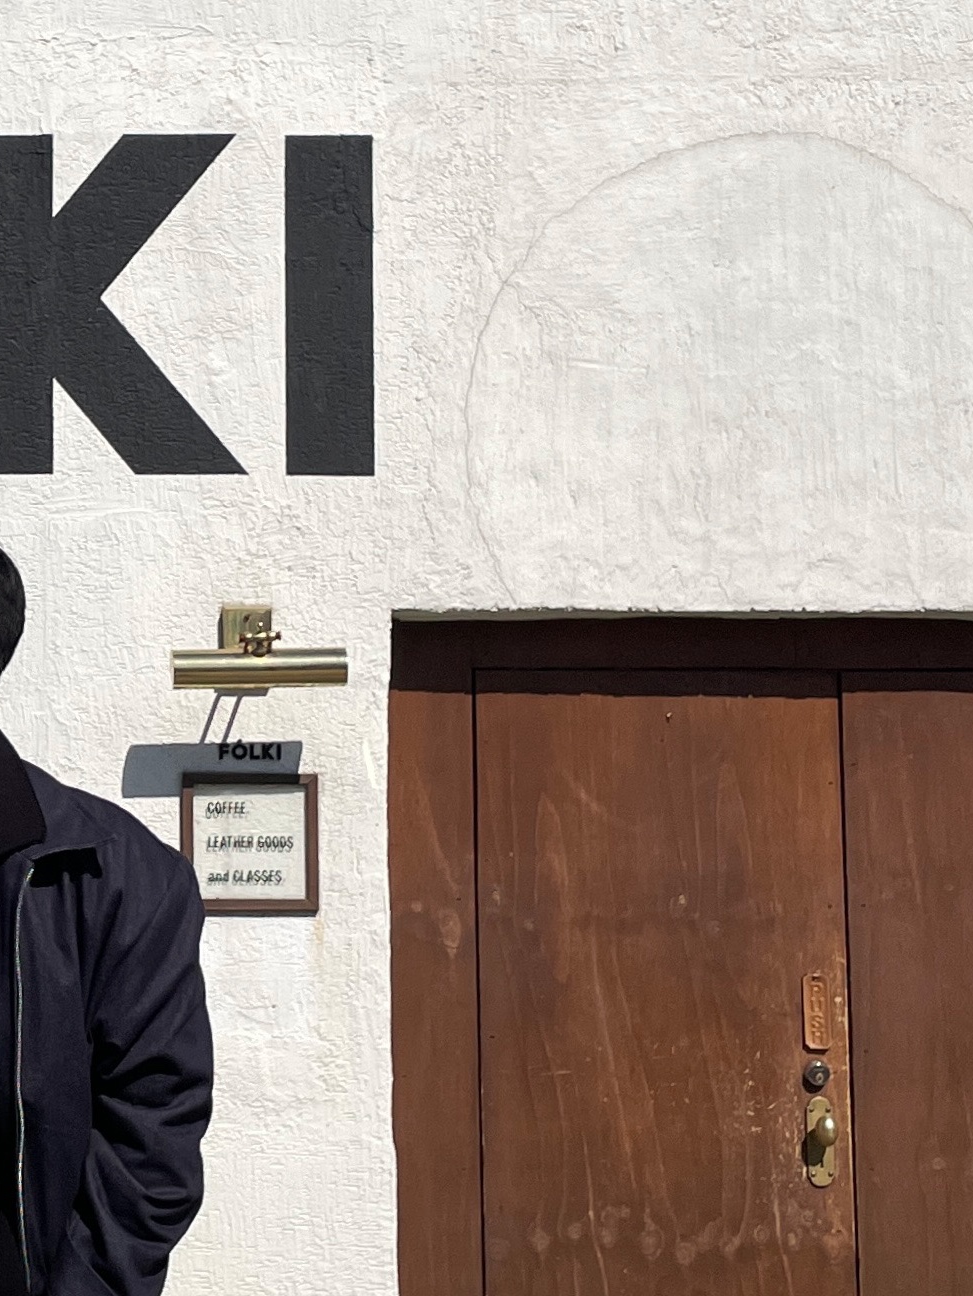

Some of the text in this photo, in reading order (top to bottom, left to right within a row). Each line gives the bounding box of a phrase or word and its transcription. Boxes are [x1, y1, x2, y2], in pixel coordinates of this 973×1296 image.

[218, 739, 282, 760] FÓLKI
[206, 835, 294, 849] LEATHER GOODS
[207, 870, 229, 882] and
[810, 982, 825, 1045] PUSH
